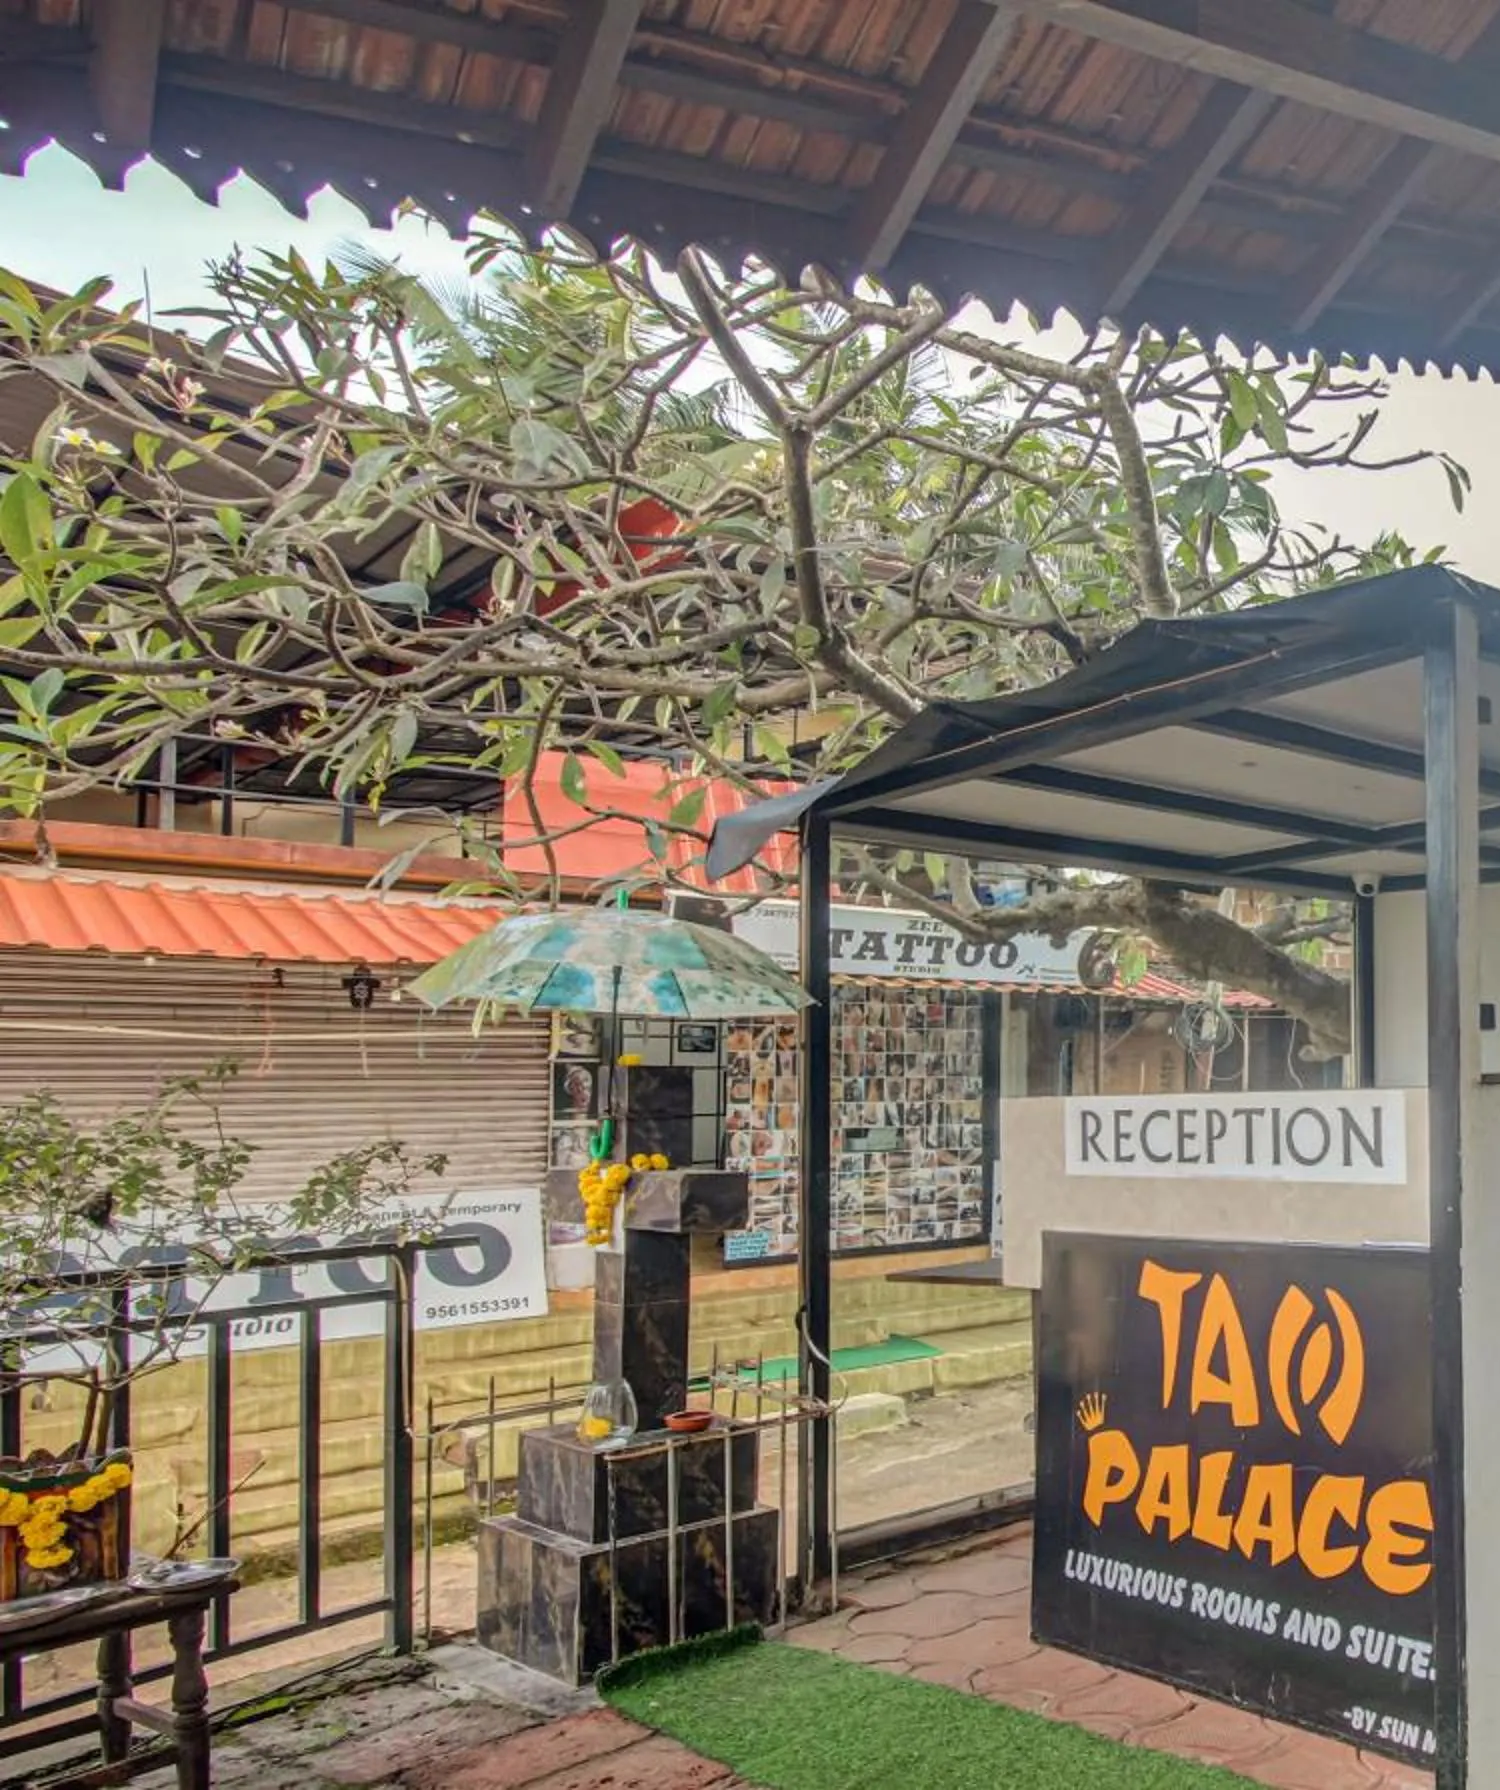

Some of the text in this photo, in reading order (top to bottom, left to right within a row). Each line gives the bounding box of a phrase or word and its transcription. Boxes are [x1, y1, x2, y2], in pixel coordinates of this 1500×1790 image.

[830, 929, 1019, 969] TATTOO
[1080, 1106, 1385, 1168] RECEPTION
[441, 1201, 522, 1218] Temporary
[426, 1296, 529, 1319] 9561553391
[1137, 1259, 1366, 1446] TAO
[1083, 1429, 1435, 1596] PALACE
[1065, 1549, 1437, 1681] LUXURIOUS ROOMS AND SUITE
[1377, 1715, 1421, 1749] SUN
